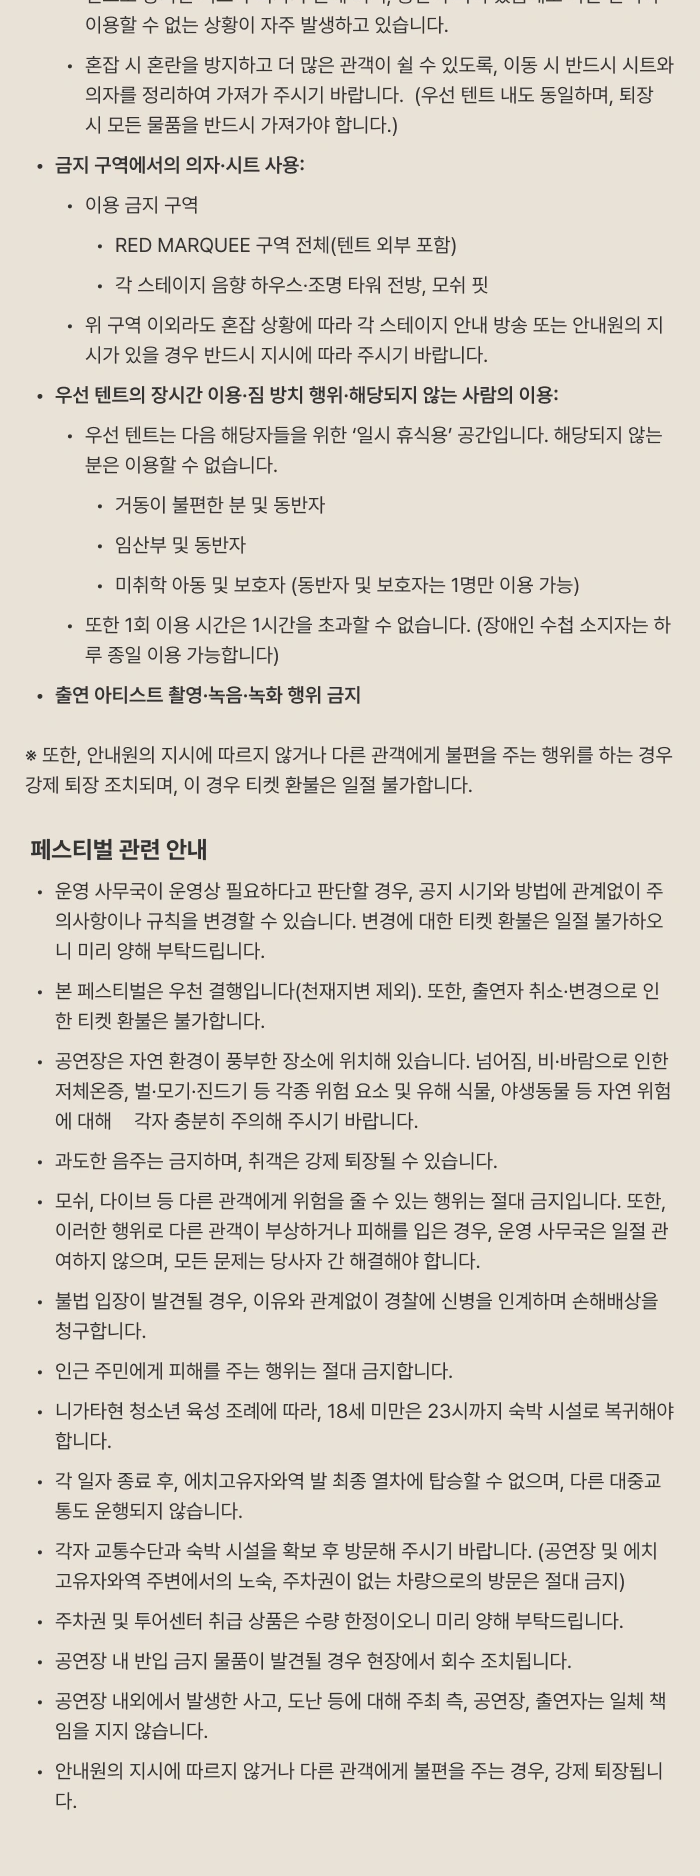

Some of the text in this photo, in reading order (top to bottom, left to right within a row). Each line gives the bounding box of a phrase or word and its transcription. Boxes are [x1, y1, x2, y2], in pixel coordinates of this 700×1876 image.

[116, 236, 456, 256] RED MARQUEE 구역 전체(텐트 외부 포함)
[116, 536, 246, 554] 임산부 및 동반자
[31, 839, 206, 860] 페스티벌 관련 안내
[57, 1402, 674, 1422] 니가타현 청소년 육성 조례에 따라, 18세 미만은 23시까지 숙박 시설로 복귀해야
[56, 1792, 76, 1810] 다.
